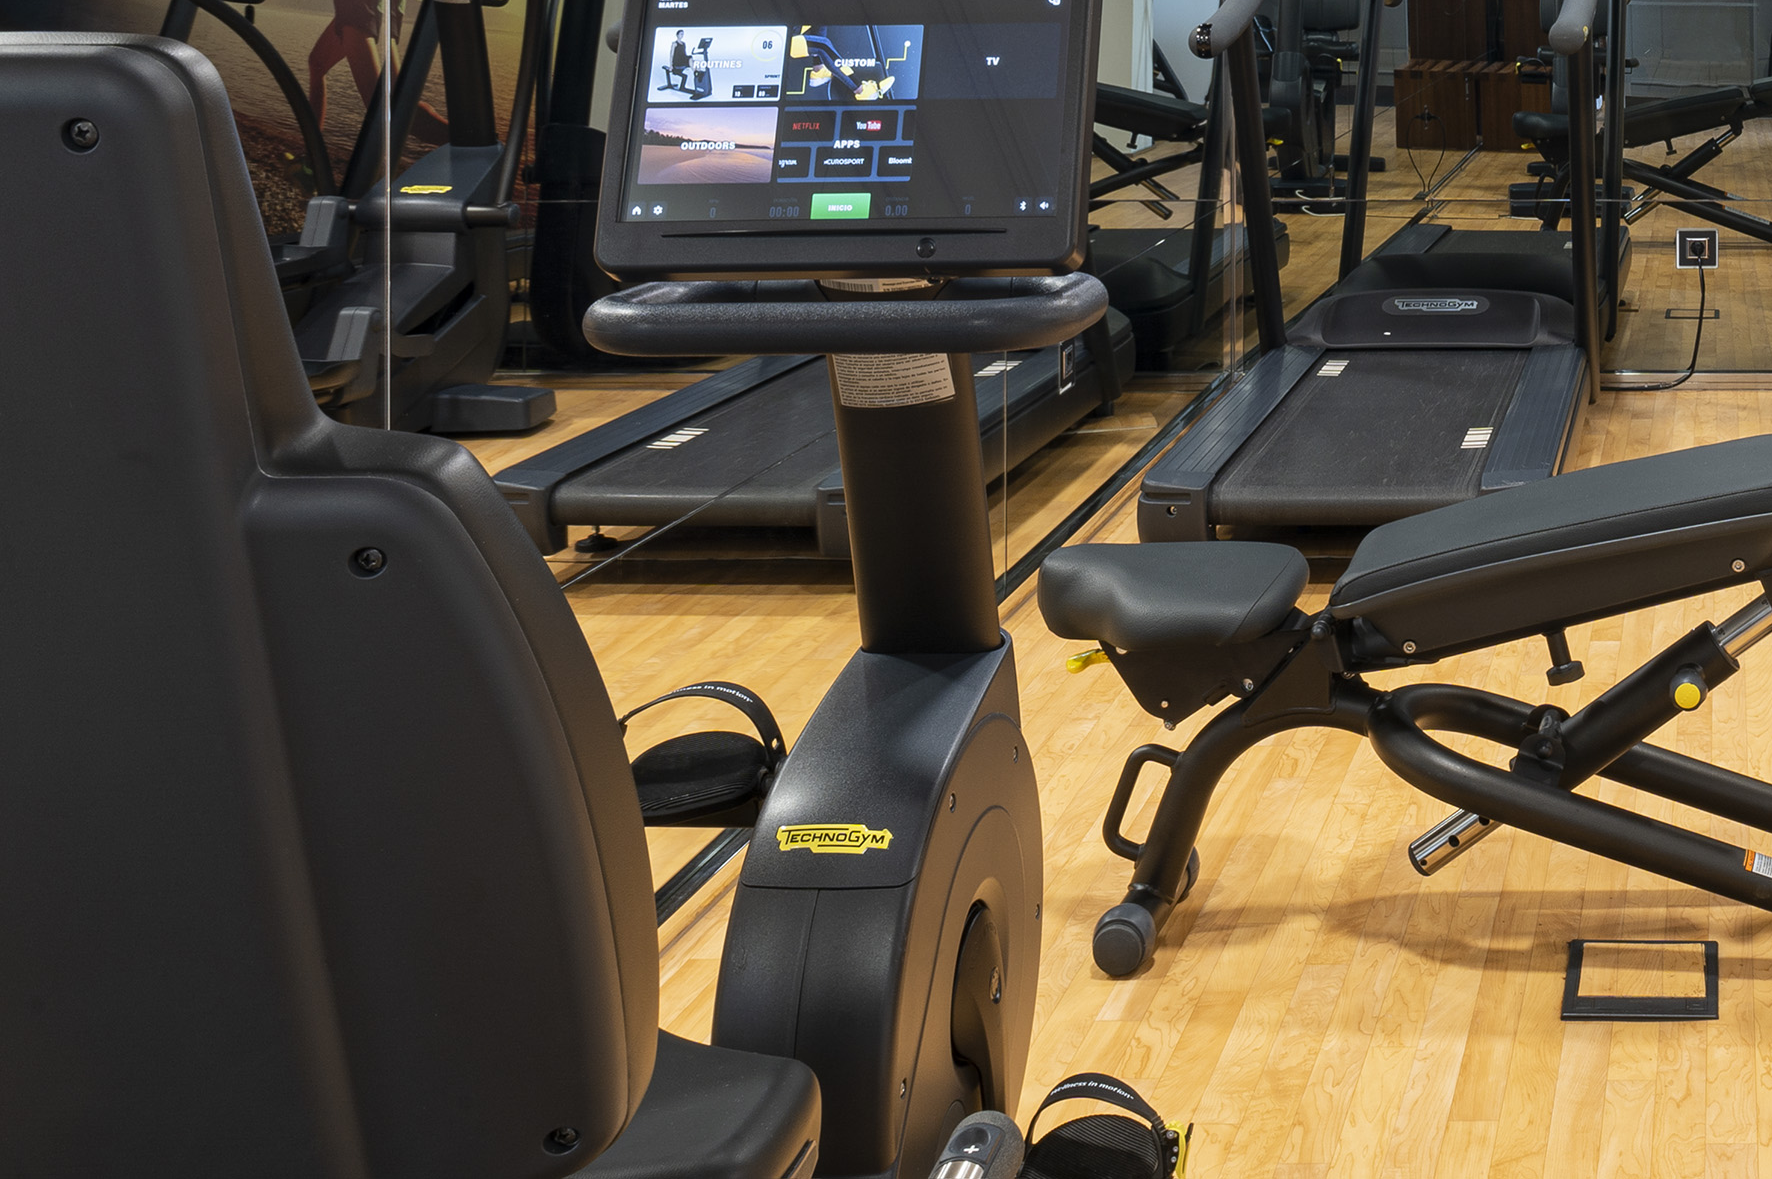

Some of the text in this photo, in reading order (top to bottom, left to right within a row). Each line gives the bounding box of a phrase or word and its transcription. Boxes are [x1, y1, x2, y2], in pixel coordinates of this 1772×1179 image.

[658, 1, 688, 9] MARTES
[762, 41, 773, 49] 06
[693, 60, 742, 69] ROUTINES
[834, 58, 875, 68] CUSTOM
[986, 57, 999, 66] TV
[792, 122, 820, 130] NETFLIX
[681, 141, 735, 151] OUTDOORS
[833, 140, 860, 149] APPS
[769, 206, 799, 218] 00:00
[885, 205, 908, 216] 0.00
[1399, 300, 1475, 310] TECHNOGYM
[781, 827, 885, 848] TECHNOGYM
